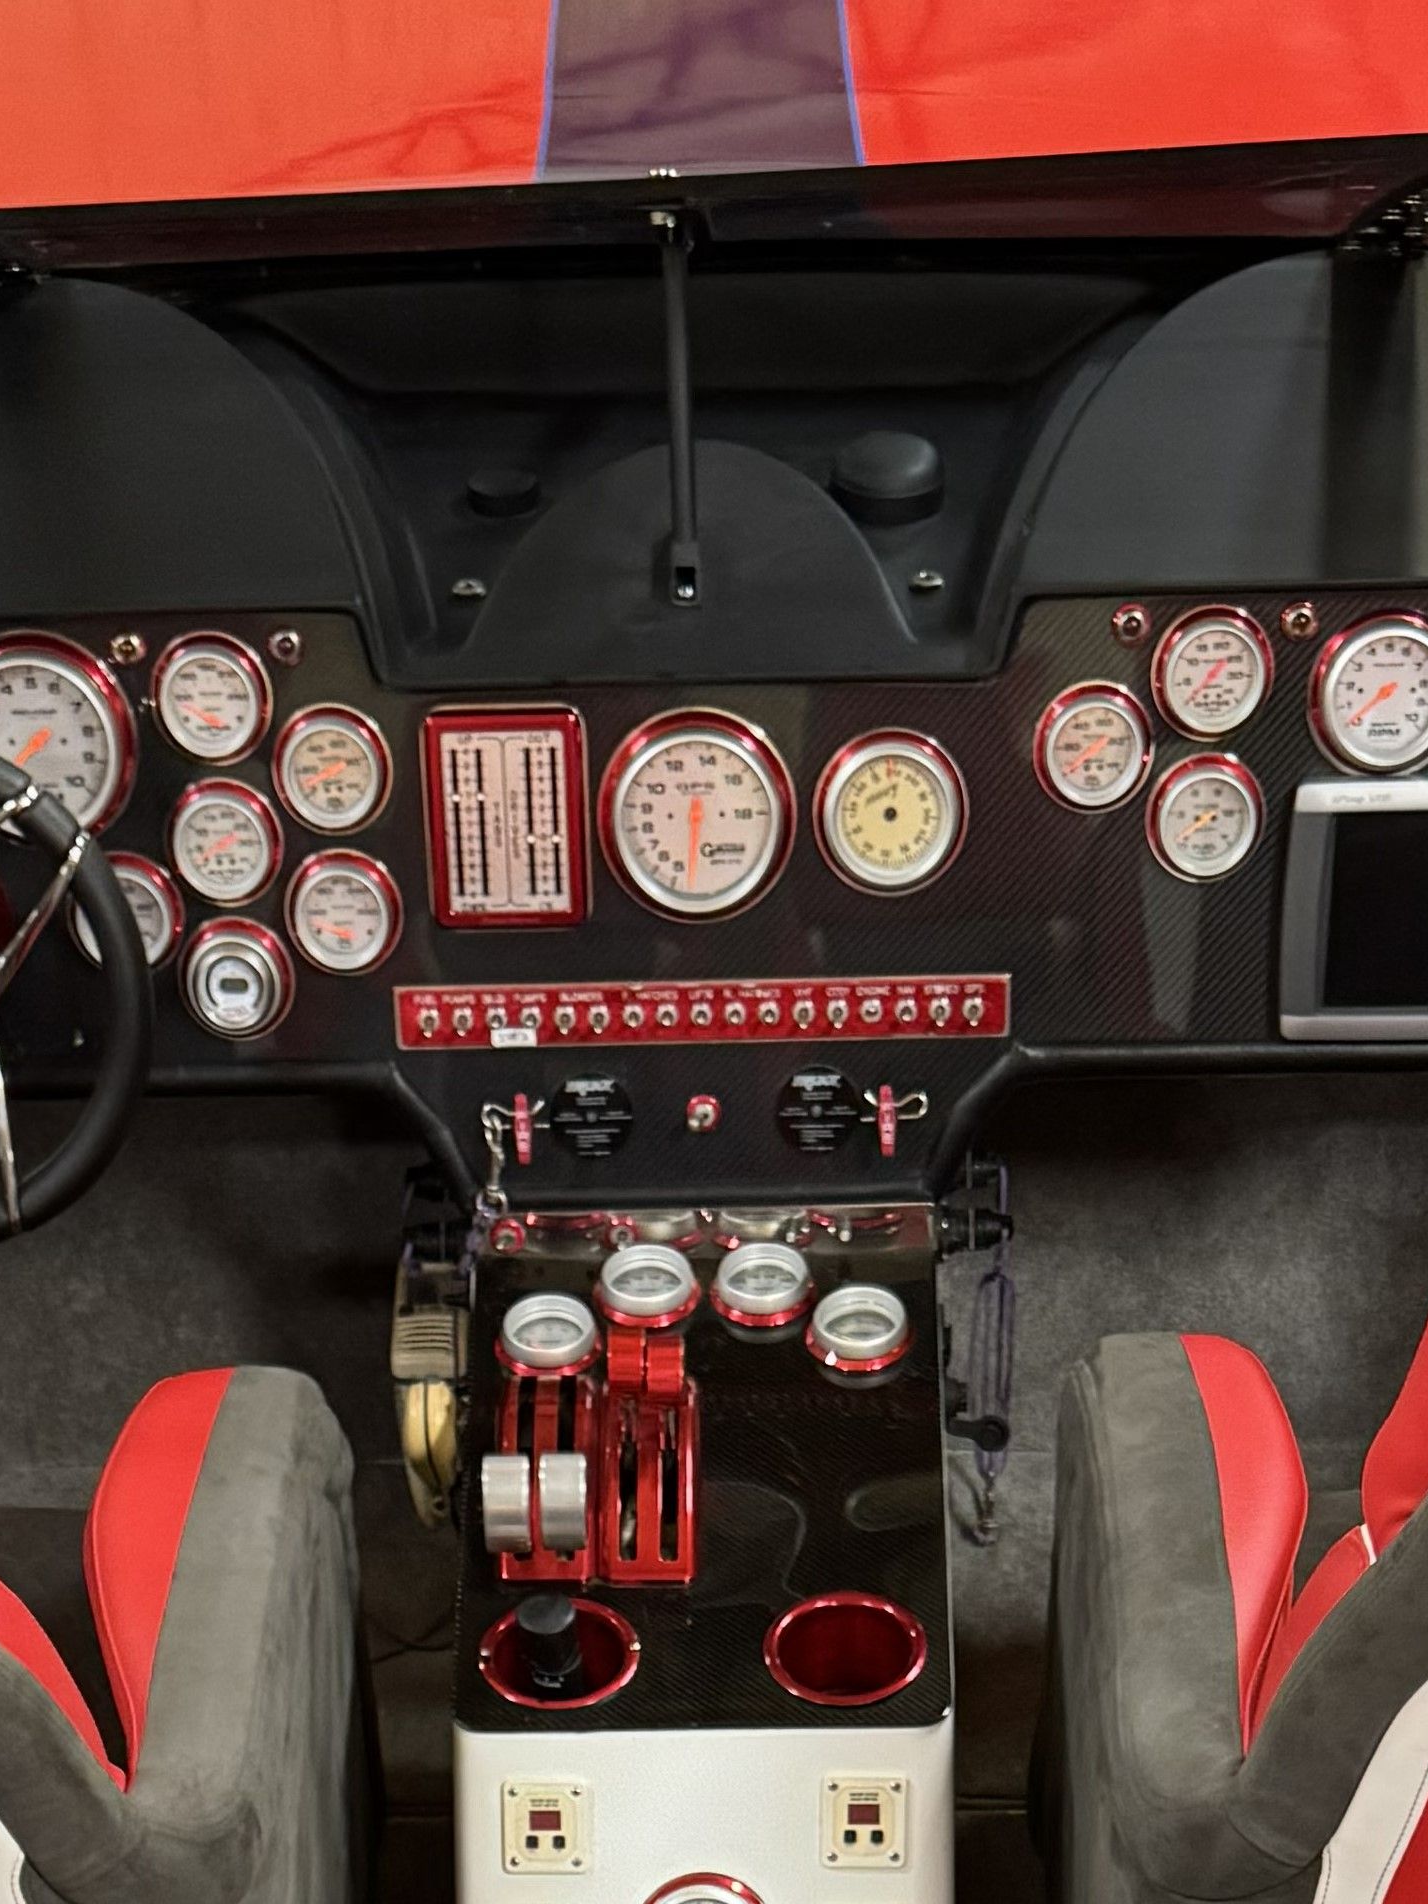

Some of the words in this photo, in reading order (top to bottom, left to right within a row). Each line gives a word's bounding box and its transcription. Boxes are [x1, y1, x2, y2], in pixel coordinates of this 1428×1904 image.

[665, 760, 683, 771] 12
[699, 755, 716, 766] 14
[647, 783, 665, 794] 10
[641, 803, 652, 814] 9
[734, 808, 752, 819] 18
[649, 839, 659, 849] 7
